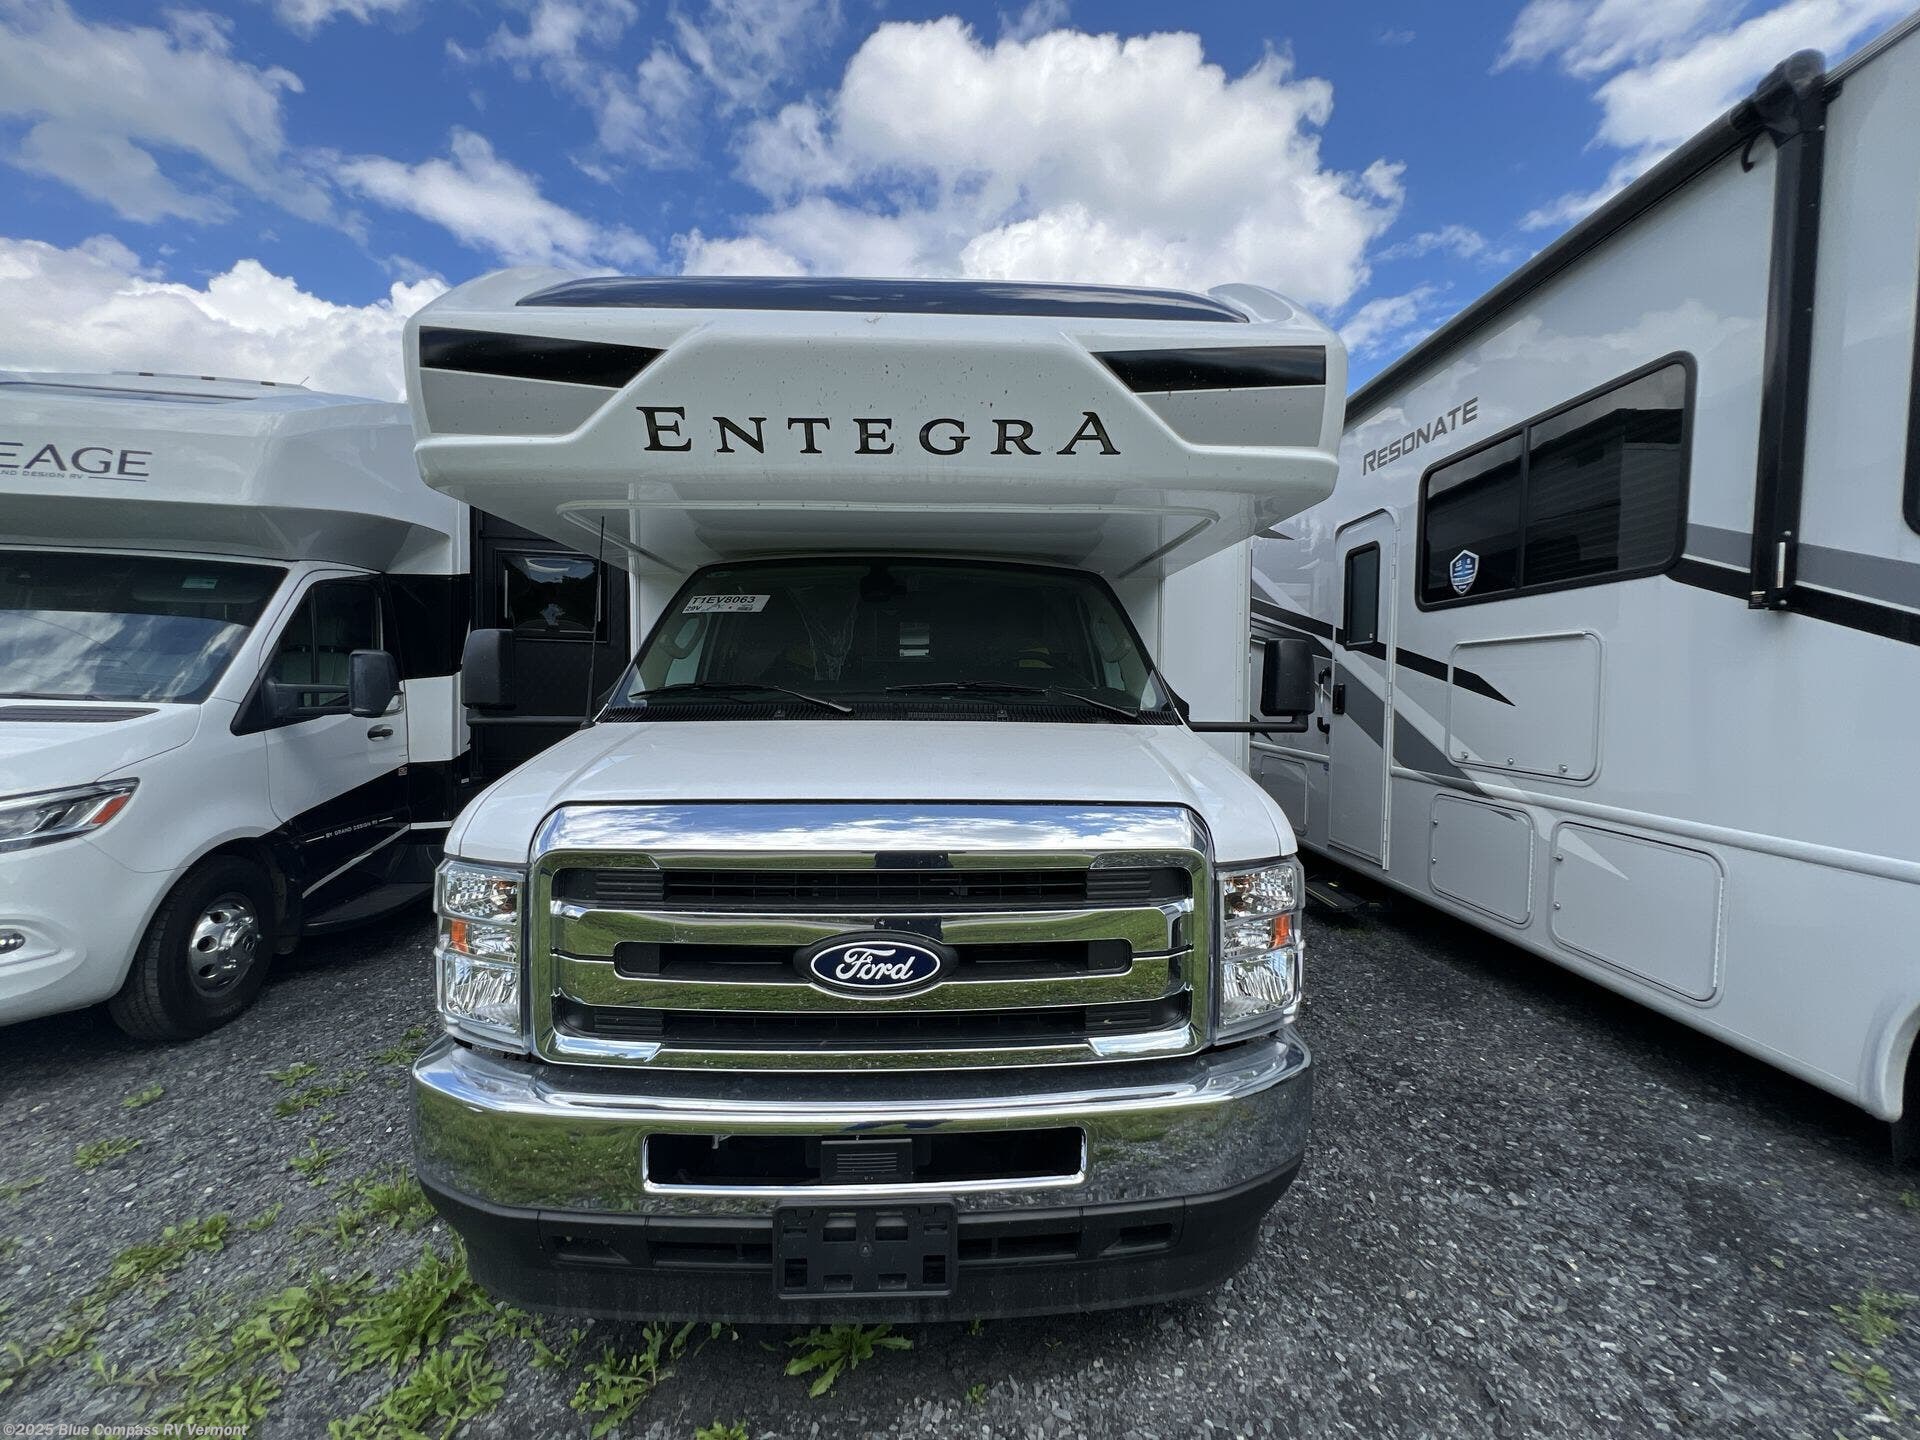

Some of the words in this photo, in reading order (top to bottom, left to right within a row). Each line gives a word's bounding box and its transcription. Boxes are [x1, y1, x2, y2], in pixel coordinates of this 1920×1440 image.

[636, 406, 1121, 456] ENTEGRA
[1363, 396, 1479, 476] RESONATE
[22, 471, 65, 479] DESIGN
[835, 947, 916, 980] Ford
